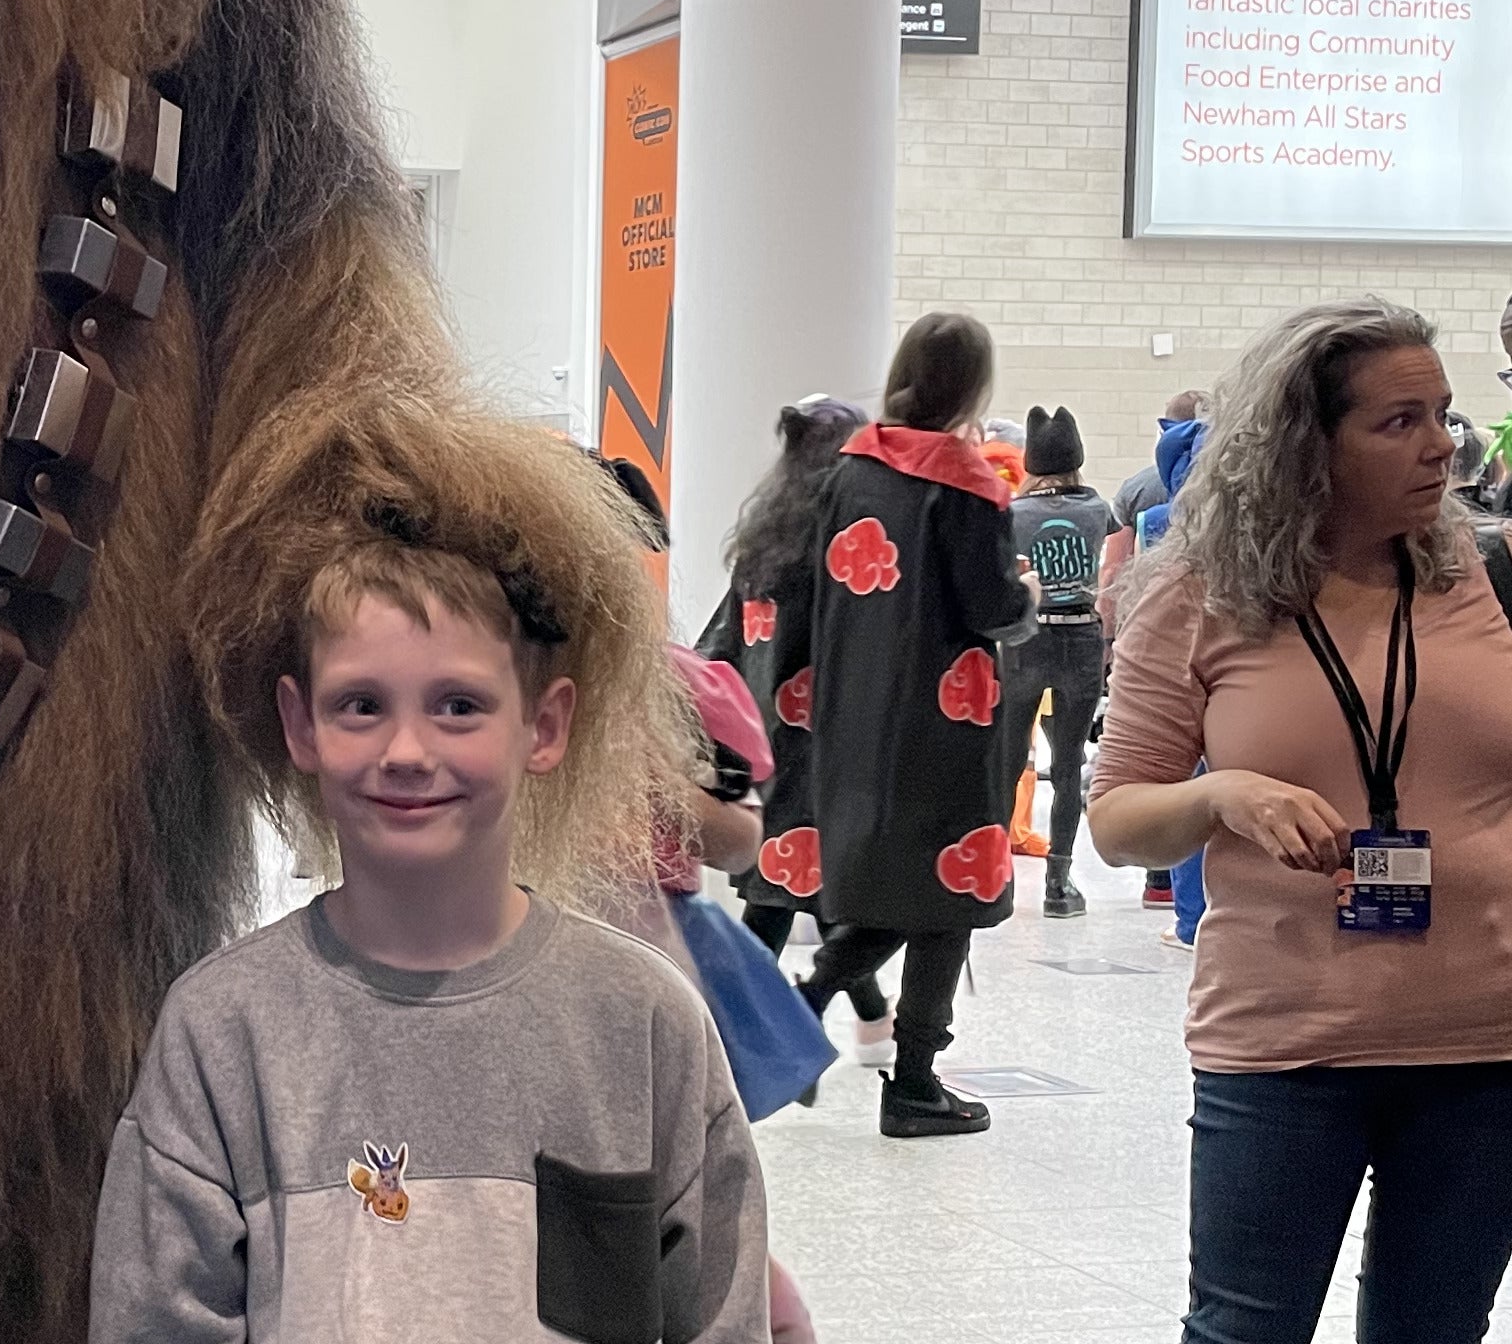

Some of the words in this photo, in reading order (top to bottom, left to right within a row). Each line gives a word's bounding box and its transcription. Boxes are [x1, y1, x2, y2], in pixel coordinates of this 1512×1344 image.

[901, 4, 927, 15] ance
[900, 20, 929, 33] egent
[1185, 24, 1300, 57] including
[1309, 29, 1455, 61] Community
[1185, 63, 1251, 88] Food
[1260, 66, 1387, 96] Enterprise
[1395, 69, 1441, 94] and
[1184, 101, 1296, 127] Newham
[1304, 104, 1336, 129] All
[1344, 106, 1407, 130] Stars
[1182, 139, 1265, 167] Sports
[1272, 141, 1396, 172] Academy.
[634, 192, 663, 219] MCM
[622, 216, 675, 247] OFFICIAL
[628, 245, 667, 271] STORE
